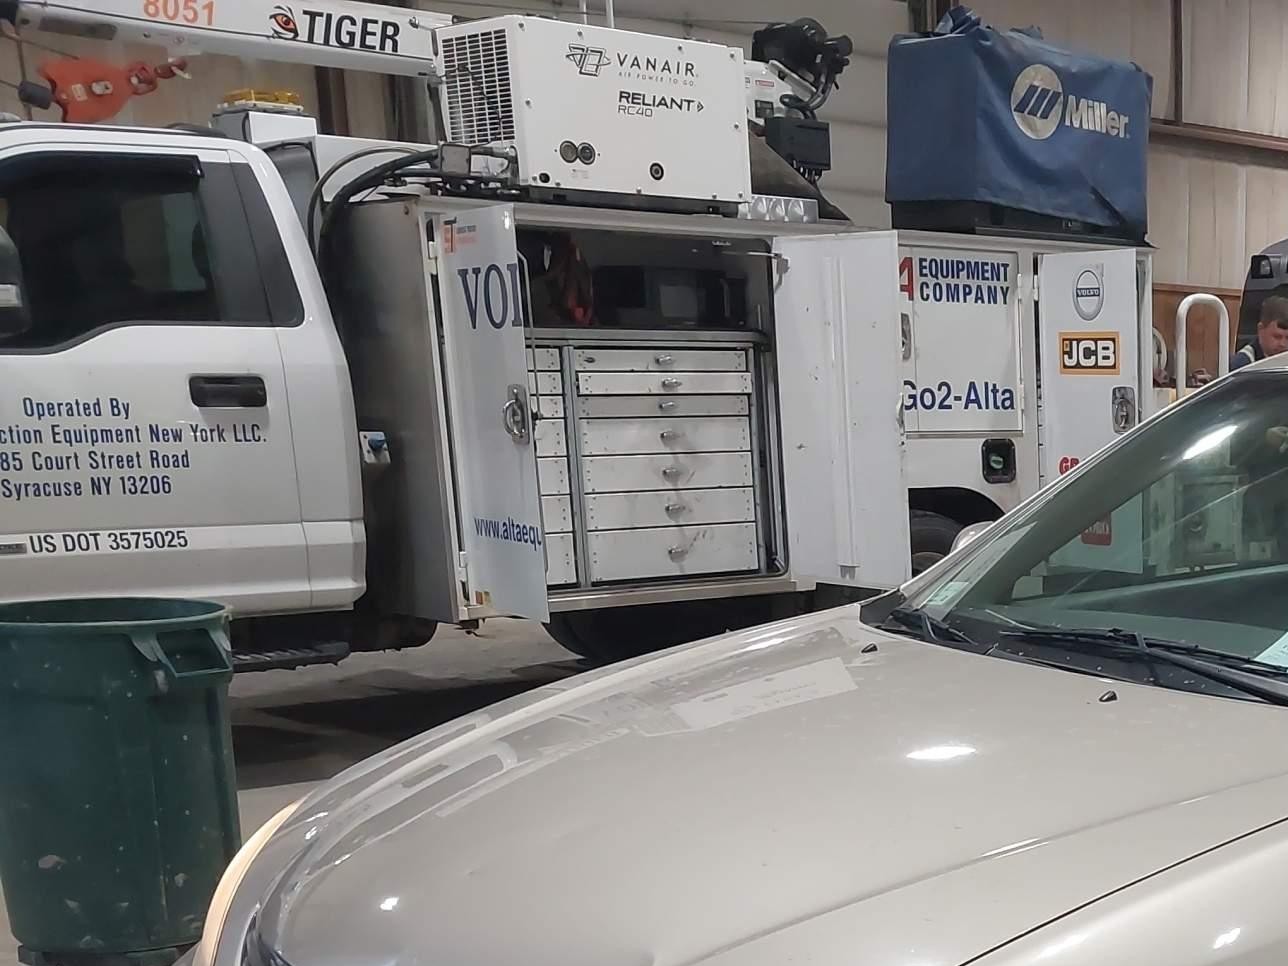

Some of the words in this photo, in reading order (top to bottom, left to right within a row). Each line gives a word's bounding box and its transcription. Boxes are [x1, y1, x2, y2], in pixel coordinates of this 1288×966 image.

[142, 0, 216, 26] 8051
[302, 10, 400, 53] TIGER
[617, 52, 695, 77] VANAIR
[617, 104, 653, 117] RC40
[618, 91, 695, 111] RELIANT
[1065, 95, 1129, 138] Miller
[918, 257, 1010, 282] EQUIPMENT
[919, 281, 1010, 305] COMPANY
[1063, 339, 1116, 367] JCB
[22, 397, 102, 421] Operated
[109, 397, 130, 420] By
[51, 424, 141, 447] Equipment
[149, 423, 183, 443] New
[189, 423, 227, 443] York
[233, 423, 267, 443] LLC.
[32, 451, 80, 470] Court
[88, 450, 142, 470] Street
[149, 449, 190, 469] Road
[1, 479, 83, 501] Syracuse
[90, 476, 111, 496] NY
[119, 475, 172, 496] 13206
[29, 534, 57, 553] US
[62, 532, 101, 552] DOT
[107, 530, 189, 550] 3575025
